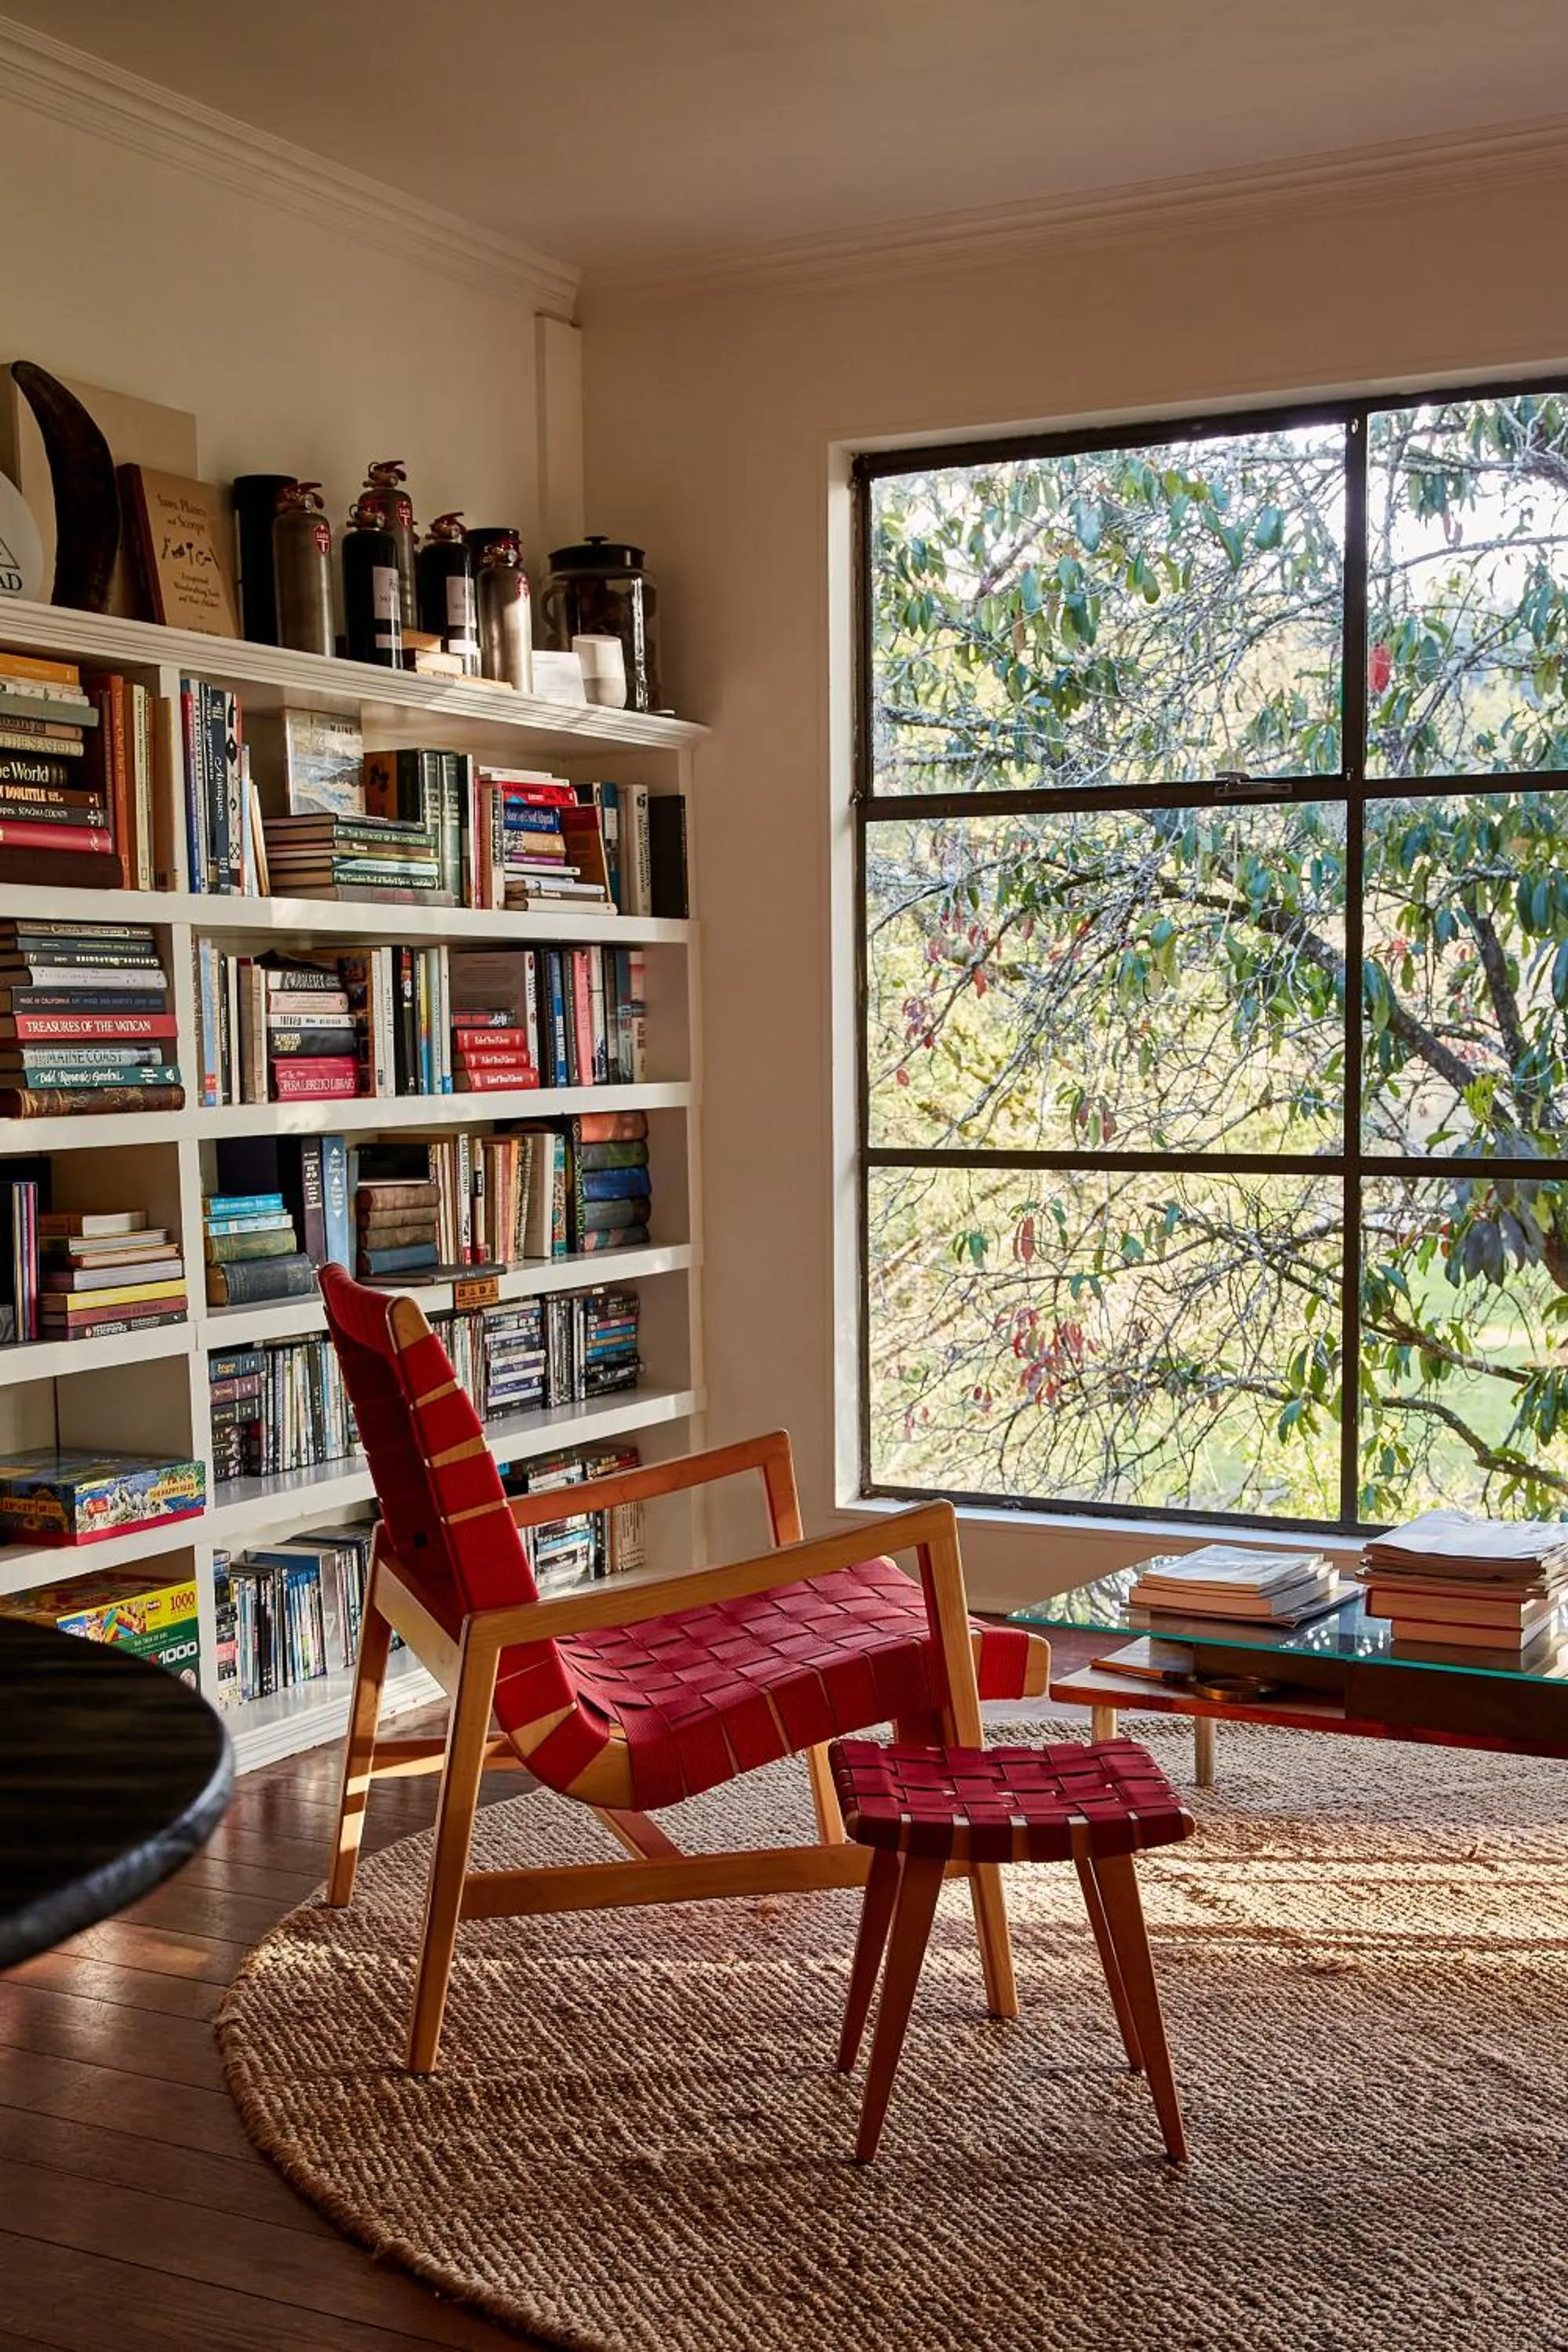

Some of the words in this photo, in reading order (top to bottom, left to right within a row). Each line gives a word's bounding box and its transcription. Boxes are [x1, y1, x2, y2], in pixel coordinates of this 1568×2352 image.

[0, 765, 9, 779] e
[11, 761, 49, 782] World
[5, 786, 46, 803] DOOLITTLE
[215, 757, 225, 821] Antiques
[26, 1019, 80, 1033] TREASURES
[81, 1020, 93, 1032] OF
[95, 1020, 114, 1033] THE
[115, 1020, 151, 1033] VATICAN
[86, 1048, 122, 1064] COAST
[169, 1591, 195, 1611] 1000
[158, 1641, 197, 1664] 1000
